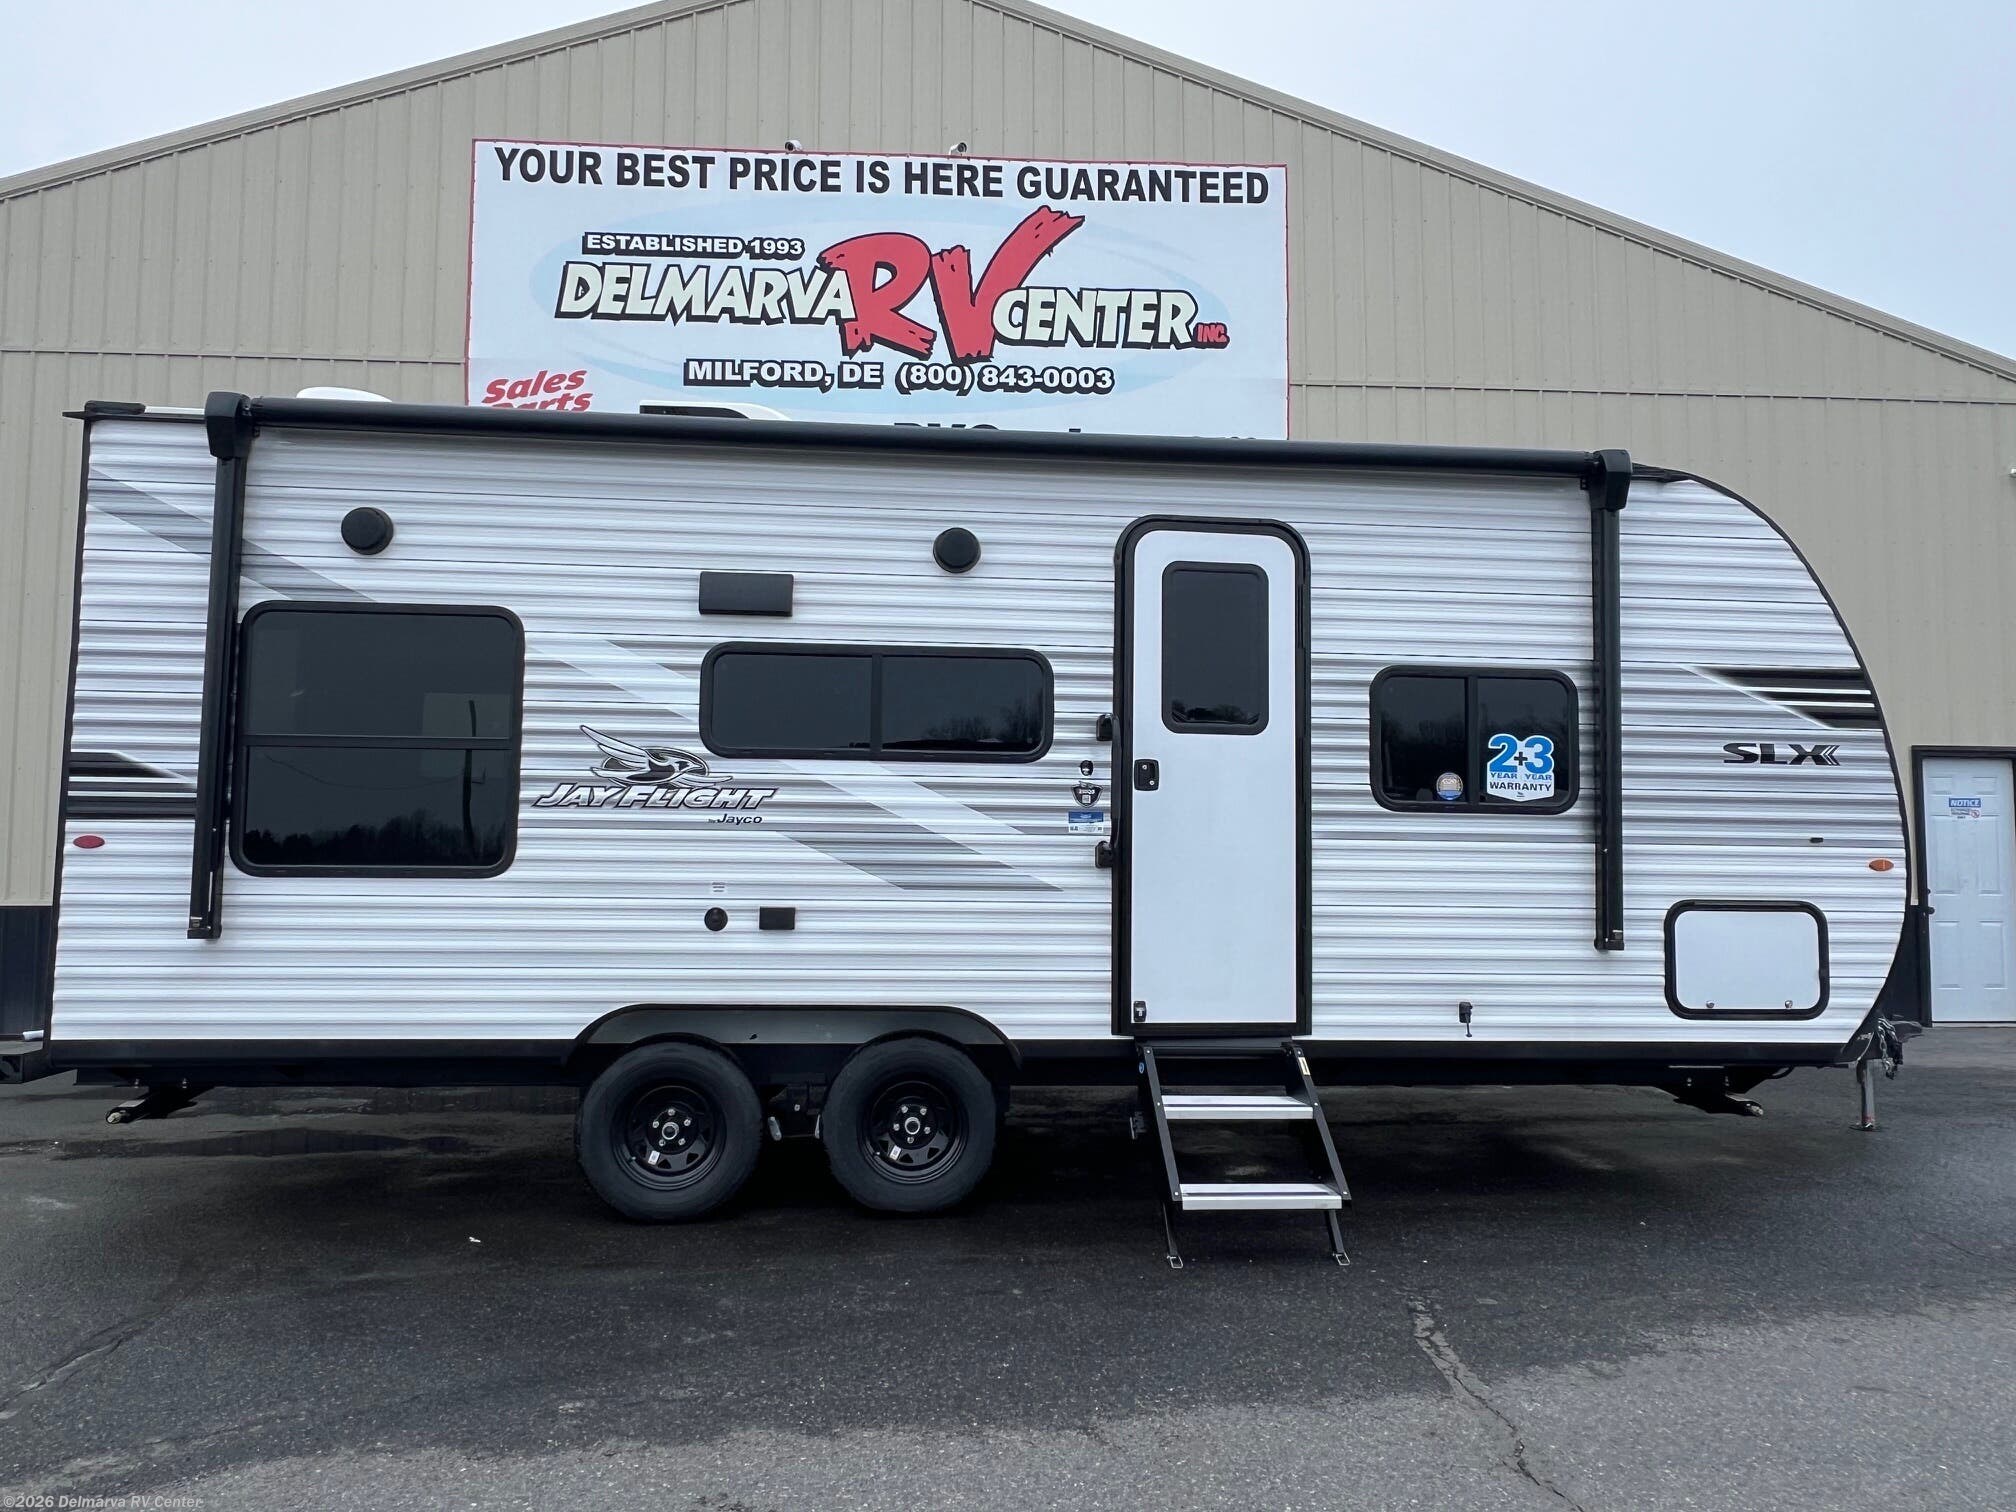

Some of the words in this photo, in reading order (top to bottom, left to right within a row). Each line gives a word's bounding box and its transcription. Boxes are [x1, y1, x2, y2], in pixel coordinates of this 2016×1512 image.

[495, 147, 602, 185] YOUR
[616, 152, 715, 189] BEST
[729, 157, 841, 193] PRICE
[856, 160, 890, 194] IS
[905, 162, 1003, 198] HERE
[1017, 166, 1269, 204] GUARANTEED
[585, 233, 744, 255] ESTABLISHED
[749, 238, 804, 255] 1993
[556, 262, 857, 324] DELMARVA
[817, 205, 1086, 363] RV
[990, 286, 1198, 350] CENTER
[482, 370, 587, 404] Sales
[686, 361, 832, 387] MILFORD,
[842, 365, 883, 385] DE
[899, 365, 972, 392] (800)
[981, 367, 1115, 391] 843-0003
[1722, 742, 1840, 766] SLX
[1489, 781, 1552, 791] WARRANTY
[717, 813, 763, 825] Jayco
